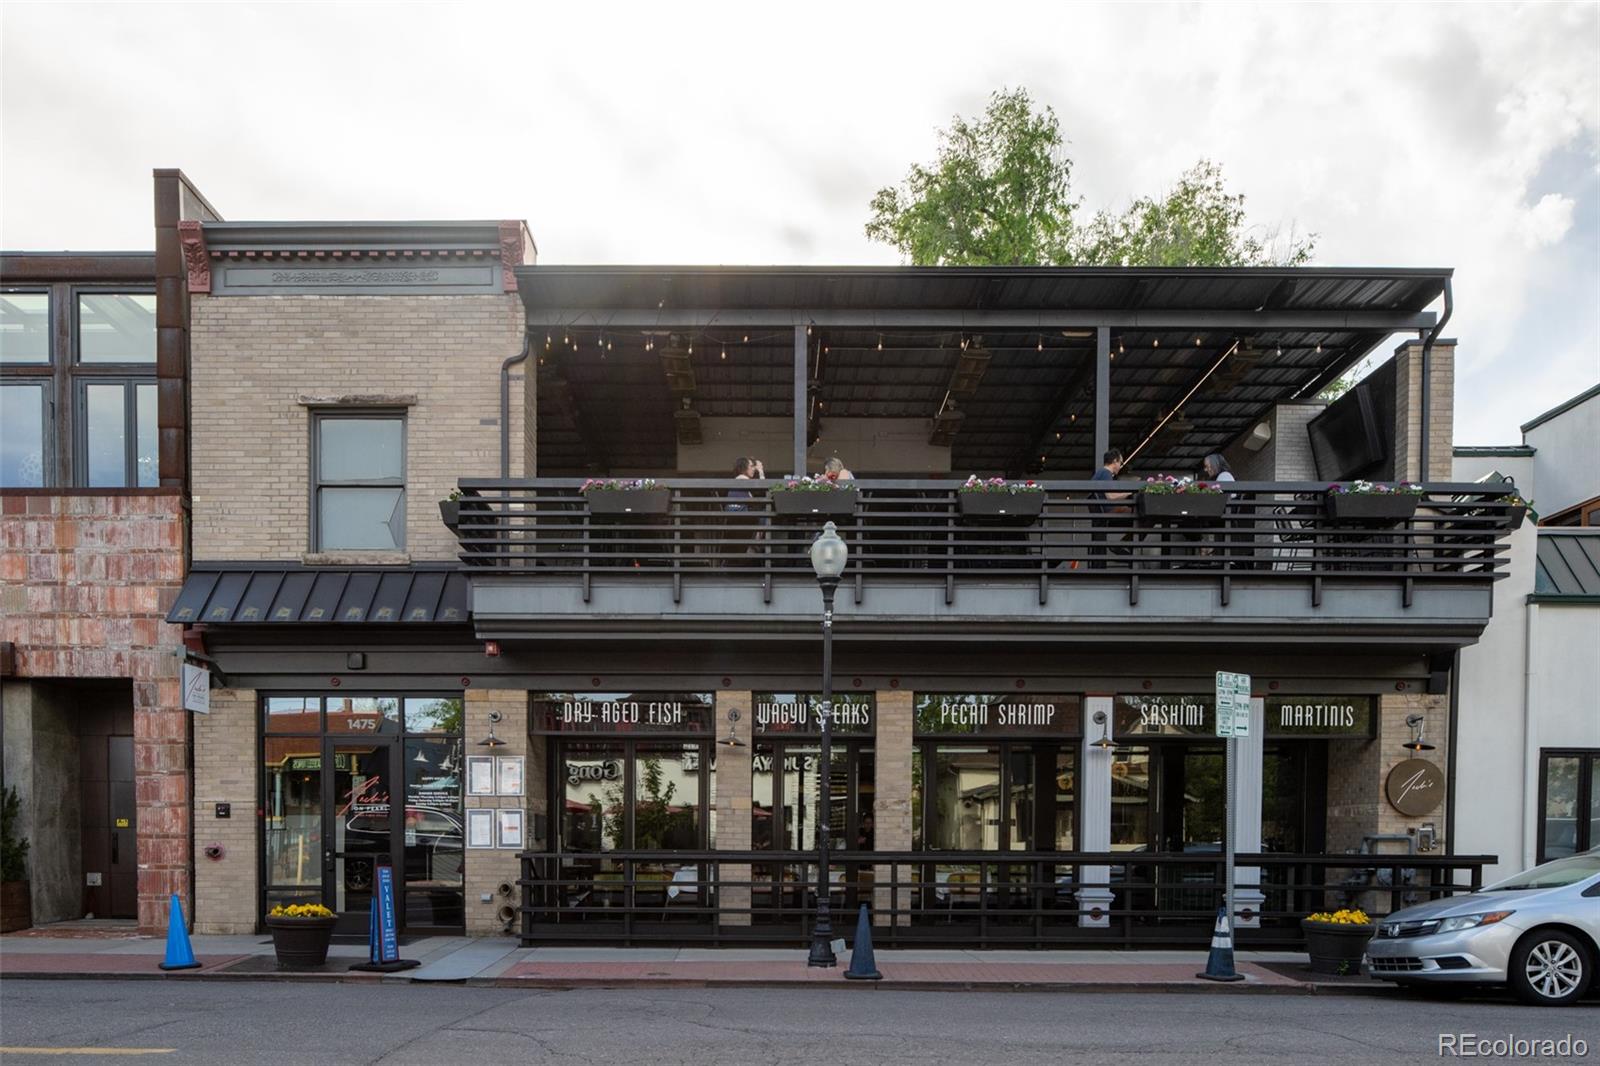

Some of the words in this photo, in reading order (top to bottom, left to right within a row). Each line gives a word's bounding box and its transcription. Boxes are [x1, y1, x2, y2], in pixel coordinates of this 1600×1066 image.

[648, 702, 681, 723] FISH
[757, 703, 807, 724] WAGYU
[815, 703, 869, 725] SEAKS
[941, 703, 988, 725] PECAN
[998, 703, 1055, 725] SHRIMP
[1140, 704, 1205, 726] SASHIMI
[1280, 705, 1355, 727] MARTINIS
[347, 718, 376, 730] 1475
[384, 885, 392, 927] VALET
